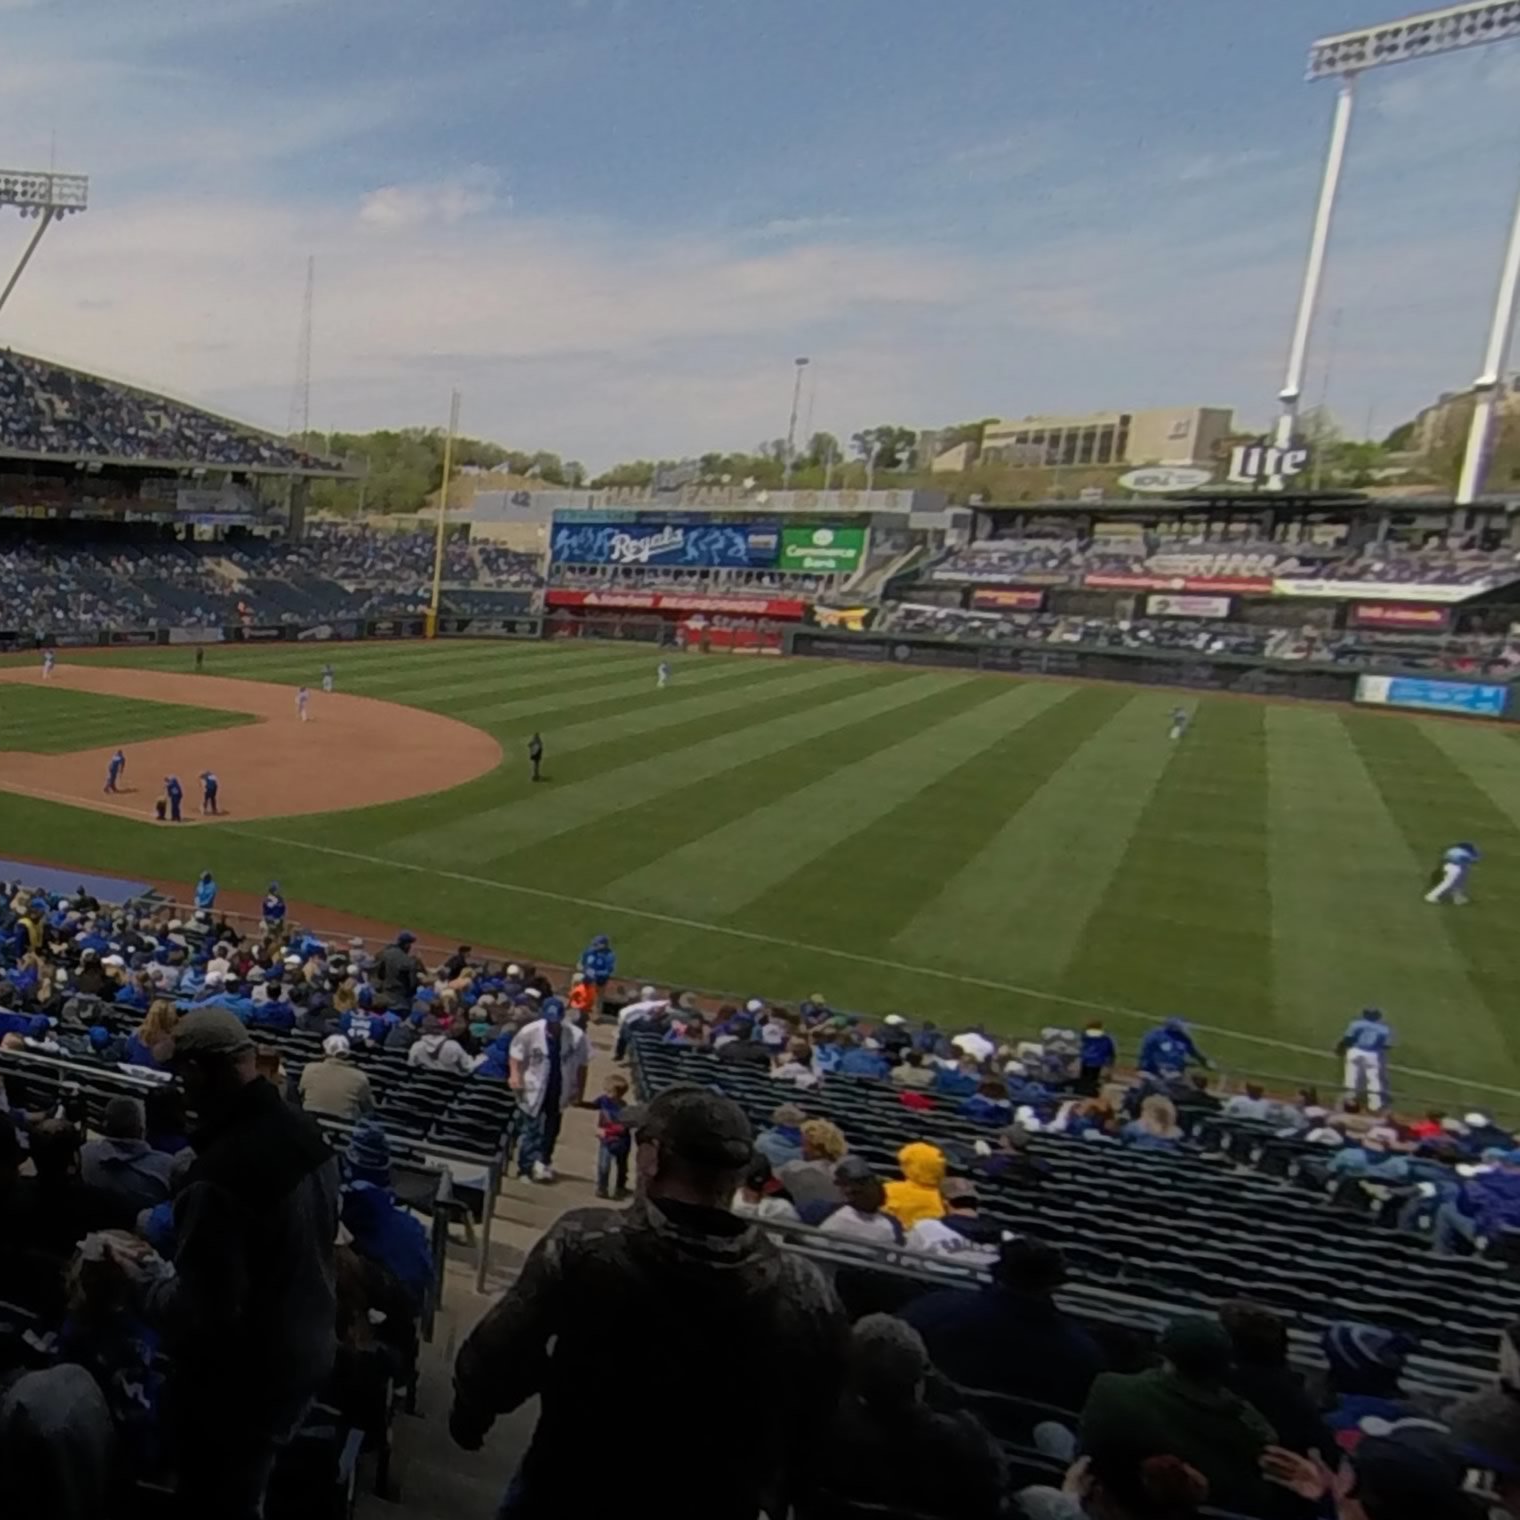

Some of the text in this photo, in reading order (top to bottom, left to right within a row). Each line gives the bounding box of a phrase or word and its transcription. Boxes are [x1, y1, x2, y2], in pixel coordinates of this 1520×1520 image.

[1228, 446, 1307, 490] Lite
[610, 524, 685, 563] Royals
[786, 544, 857, 558] Commerce
[803, 556, 837, 568] Bank
[711, 614, 756, 629] State
